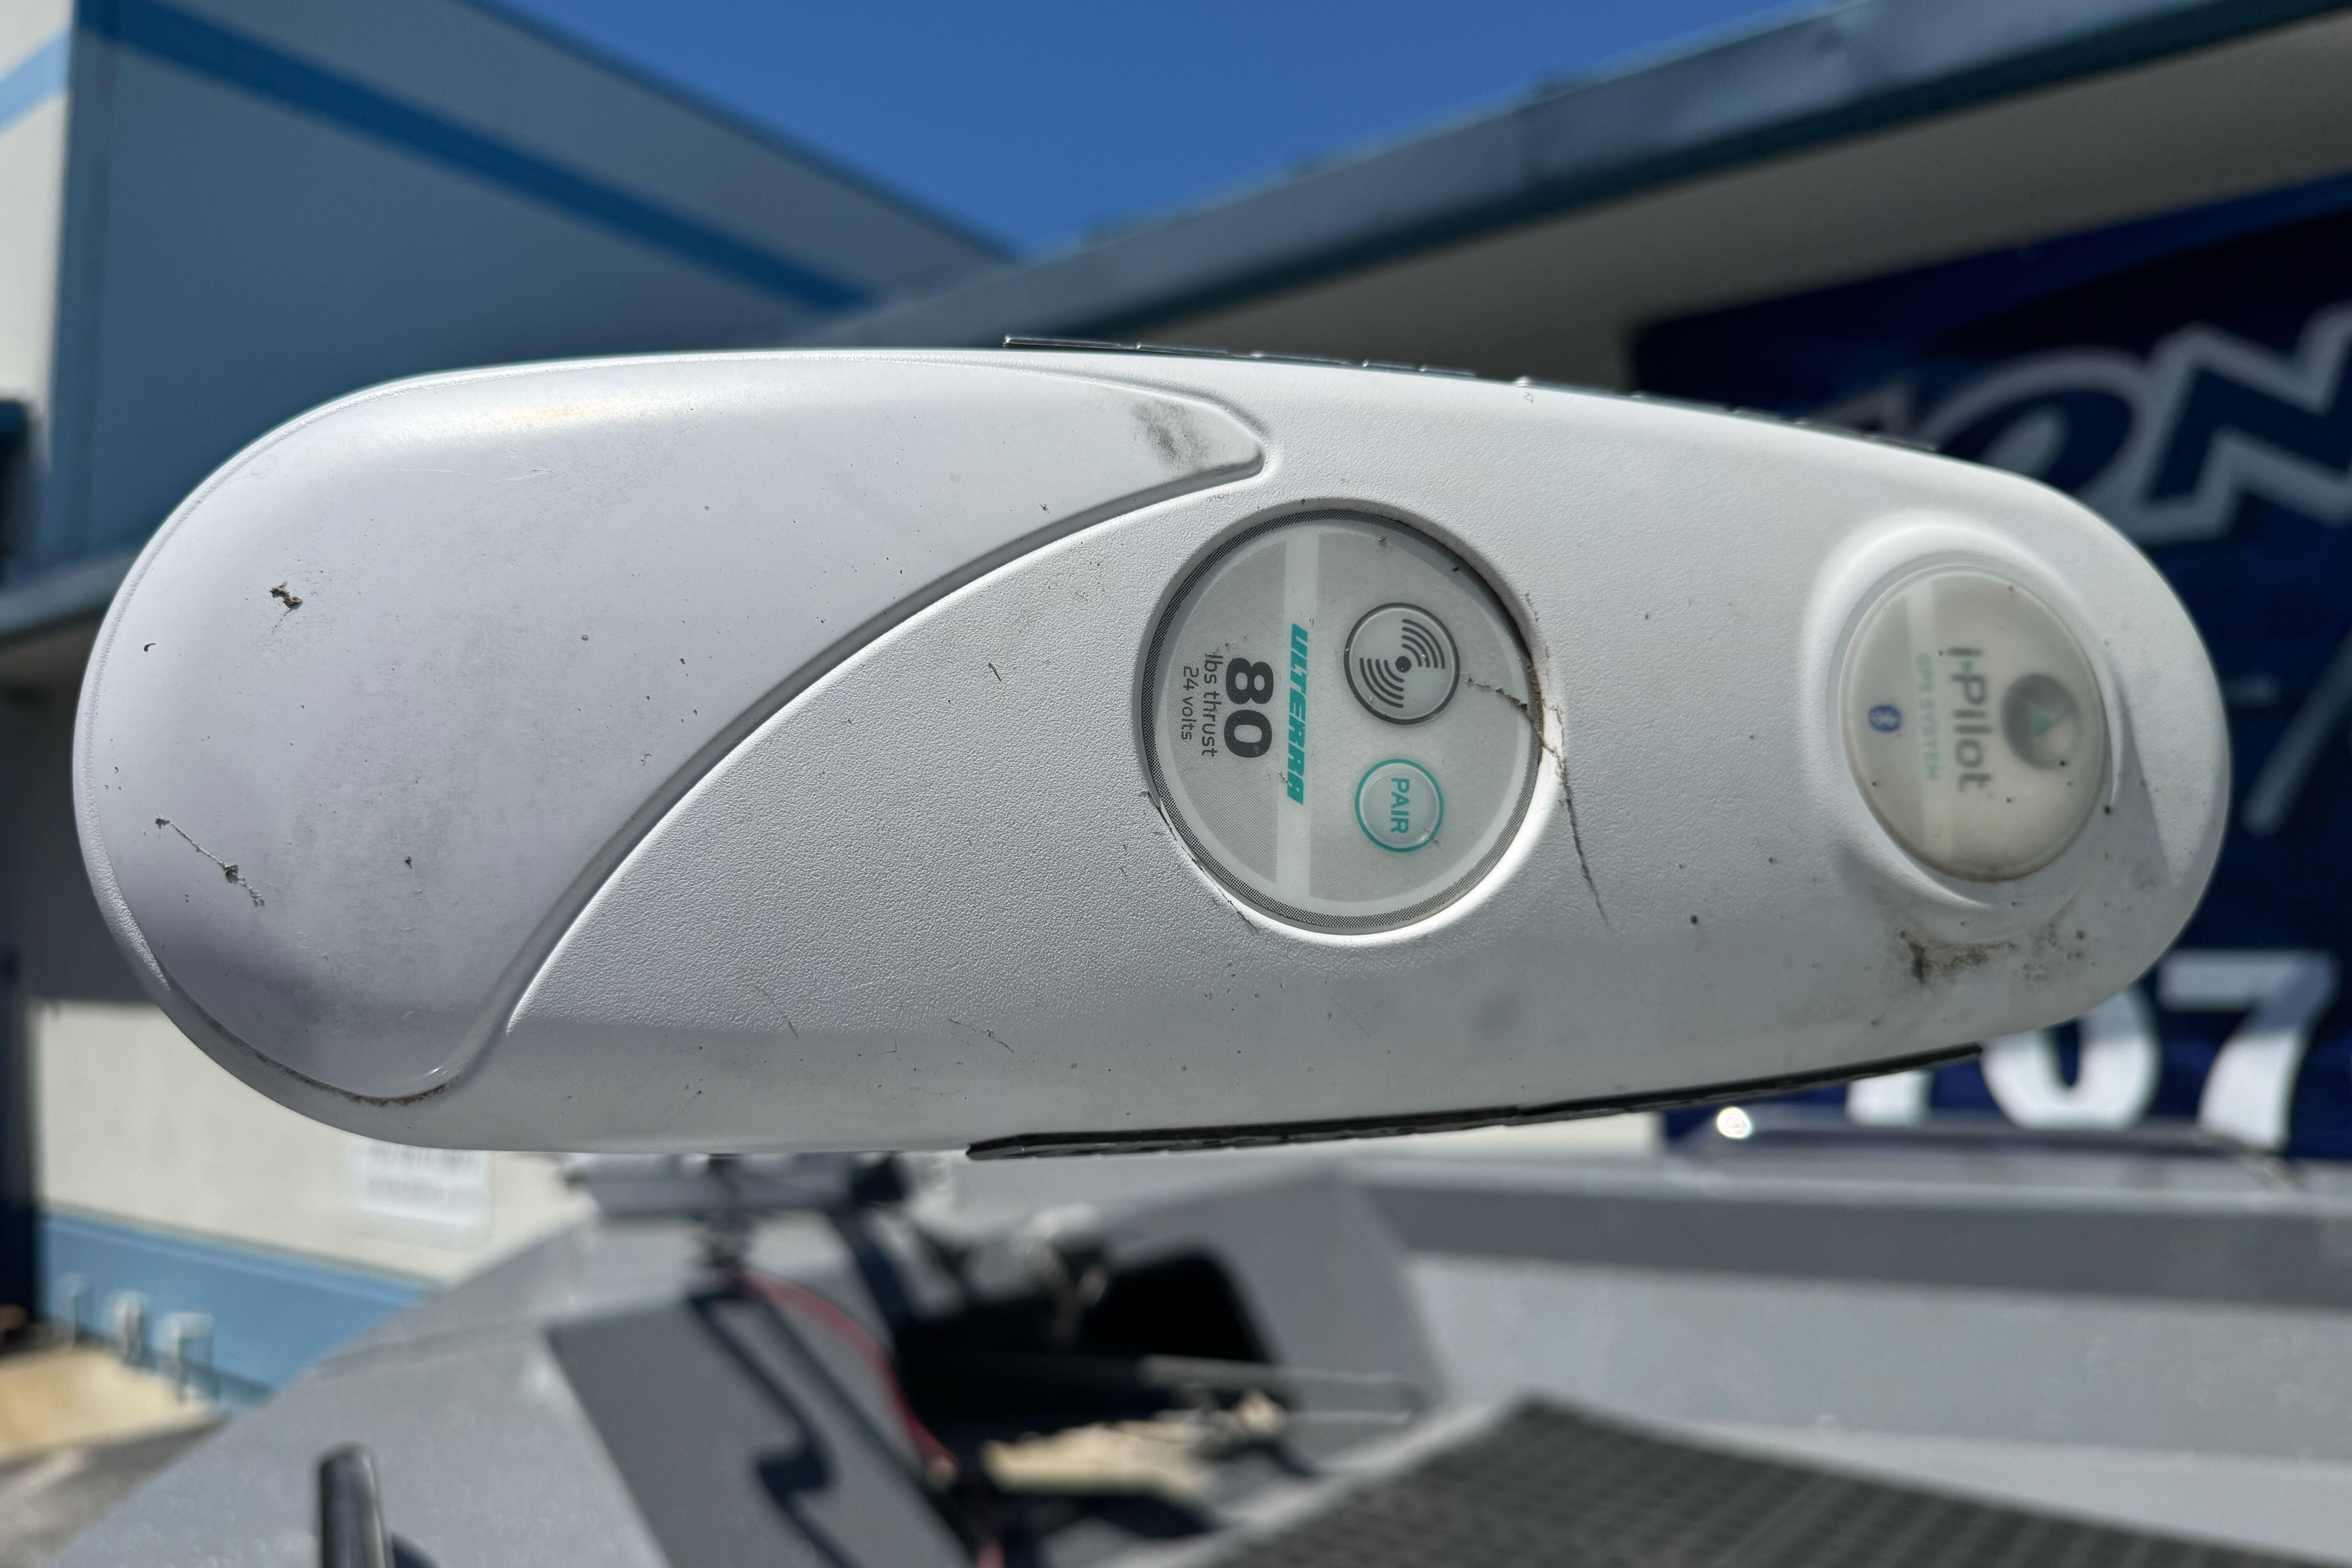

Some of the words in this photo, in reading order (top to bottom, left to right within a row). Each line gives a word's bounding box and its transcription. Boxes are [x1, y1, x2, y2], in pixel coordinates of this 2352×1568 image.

[1812, 307, 2352, 539] ON
[1183, 667, 1199, 691] 24
[1204, 654, 1223, 684] lbs
[1181, 697, 1197, 740] volts
[1202, 691, 1222, 757] thrust
[1224, 658, 1274, 758] 80
[1287, 623, 1308, 805] ULTERRA
[1390, 777, 1410, 834] PAIR
